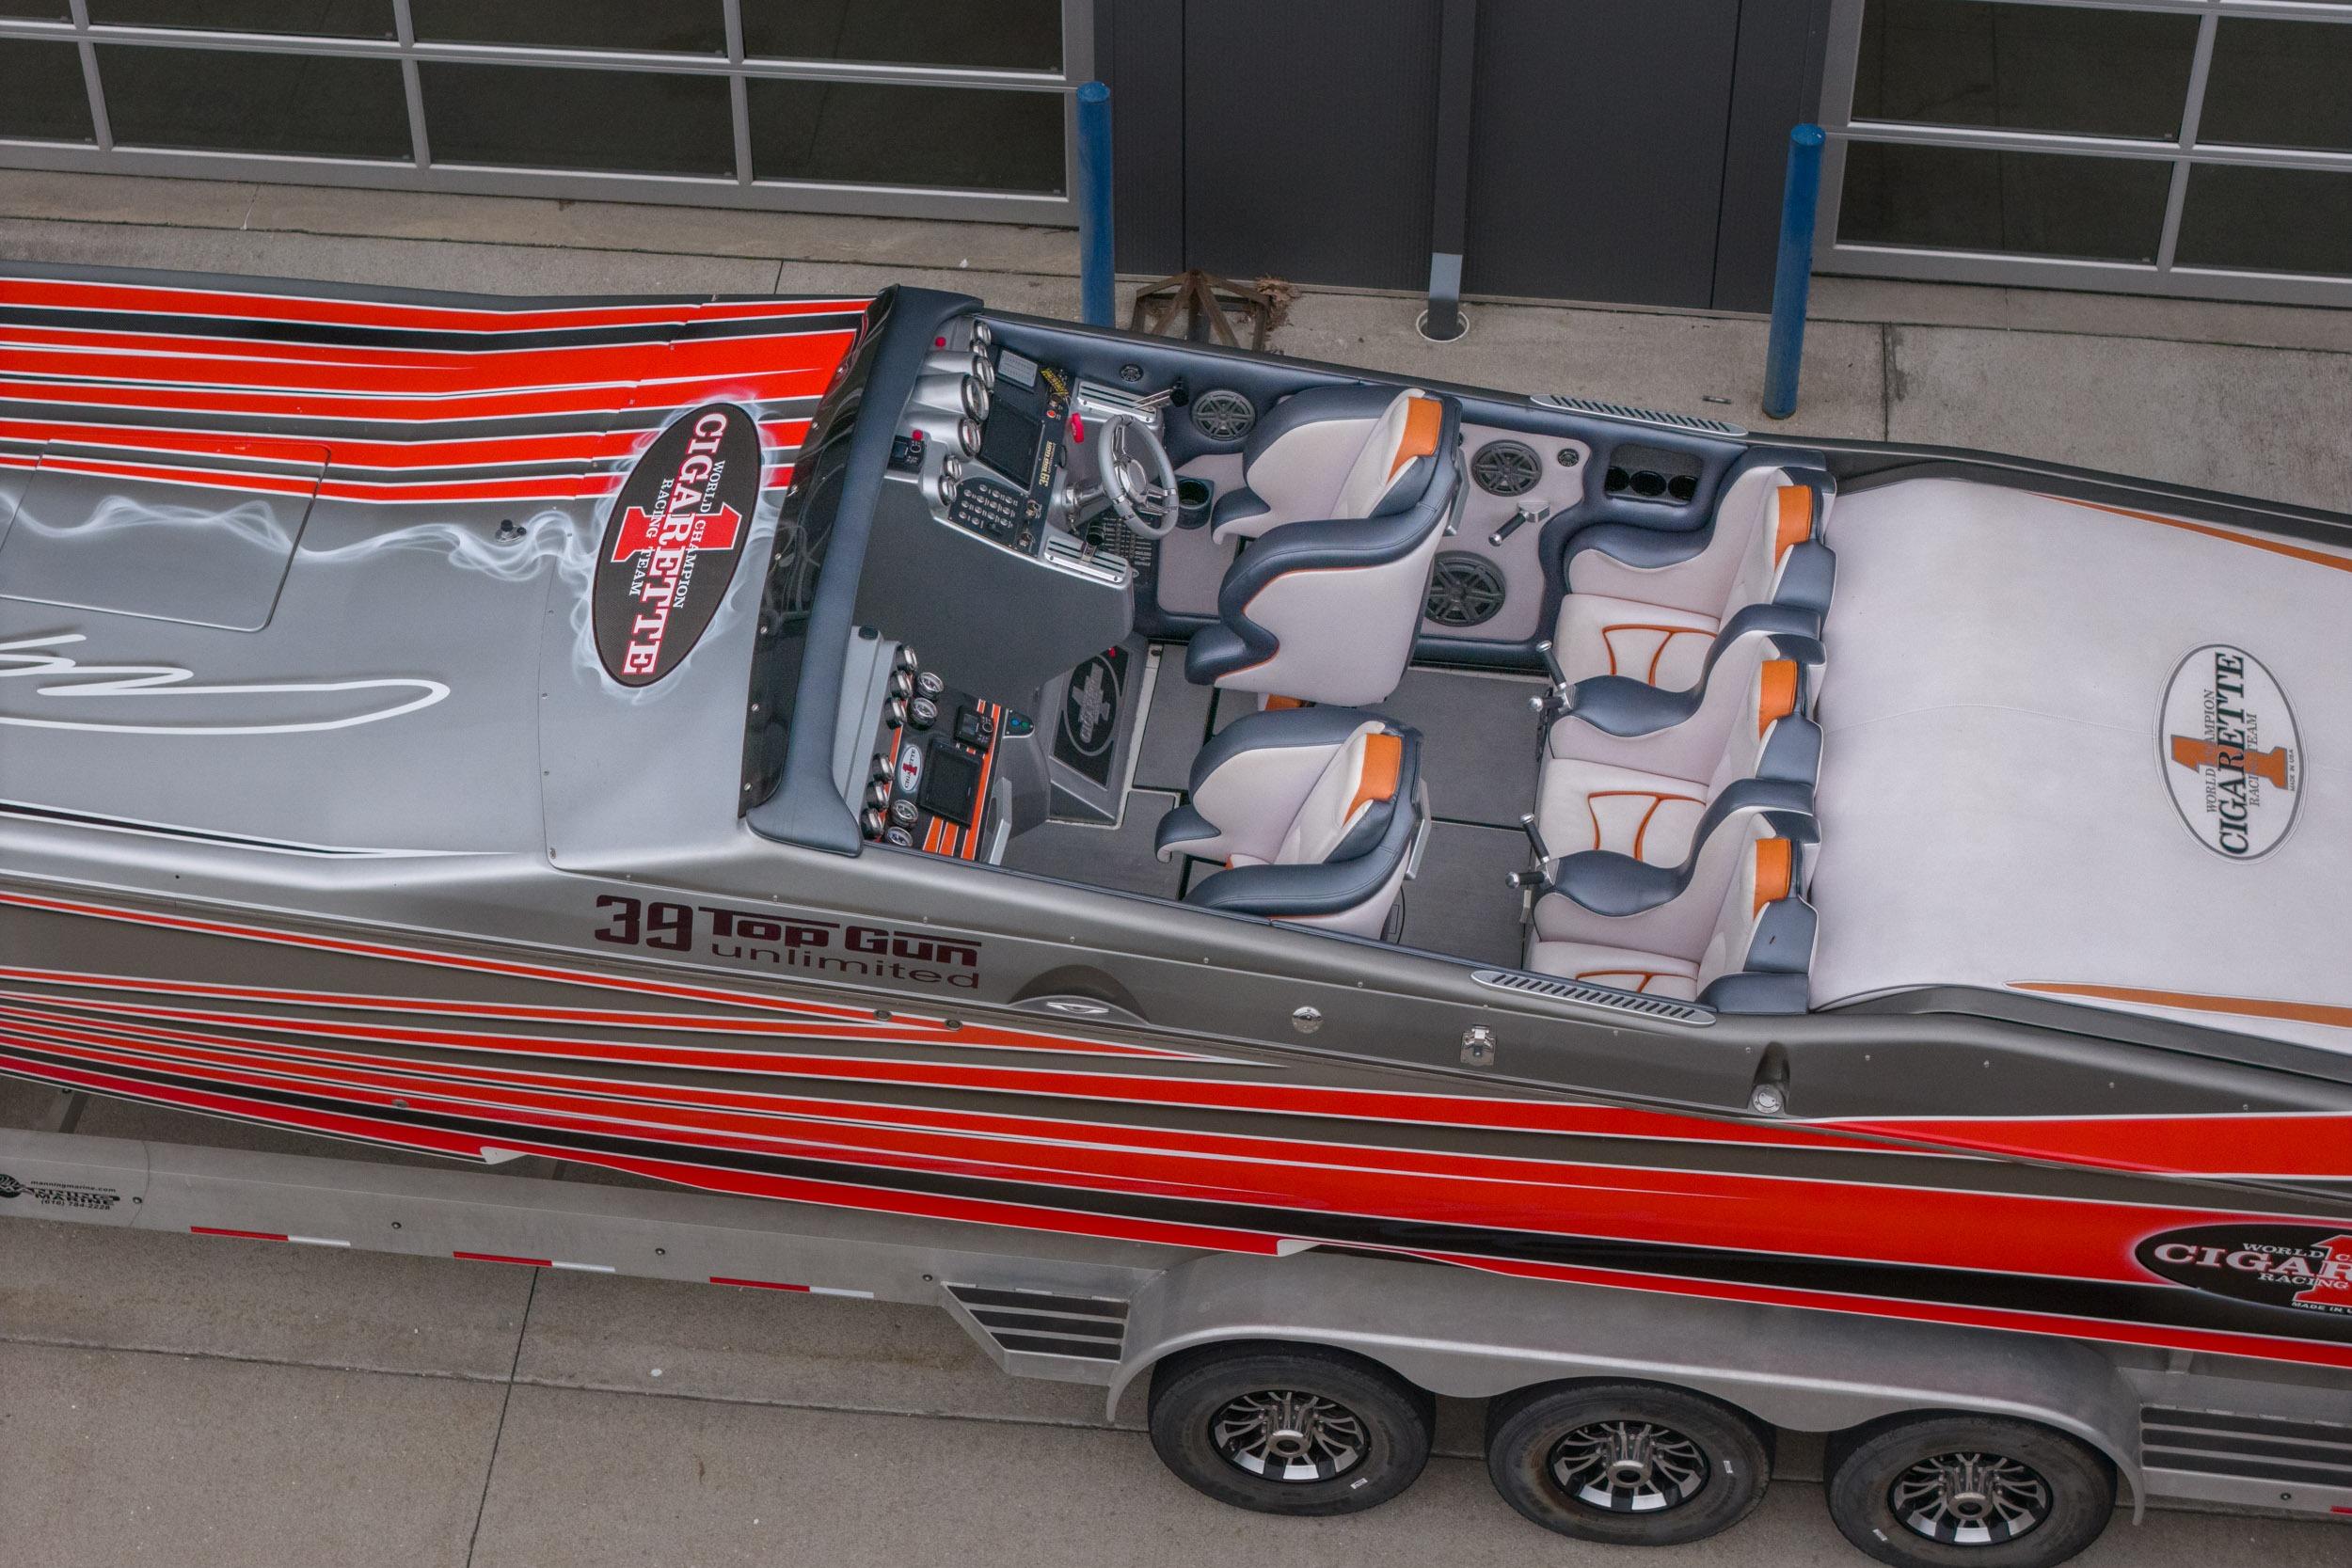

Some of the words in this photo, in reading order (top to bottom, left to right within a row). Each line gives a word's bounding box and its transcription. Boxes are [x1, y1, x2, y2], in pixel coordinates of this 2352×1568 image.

[644, 478, 675, 539] RACING
[701, 460, 726, 514] WORLD
[622, 412, 727, 674] CIGARETTE
[673, 519, 706, 610] CHAMPION
[628, 546, 655, 596] TEAM
[2215, 652, 2249, 855] CIGARETTE
[2205, 768, 2217, 813] WORLD
[595, 895, 693, 952] 39
[698, 906, 840, 947] Top
[844, 925, 982, 967] Gun
[711, 943, 979, 990] unlimited
[2153, 1243, 2352, 1281] CIGAR
[2242, 1243, 2326, 1259] WORLD
[2258, 1271, 2349, 1290] RACING
[2291, 1301, 2326, 1310] MADE
